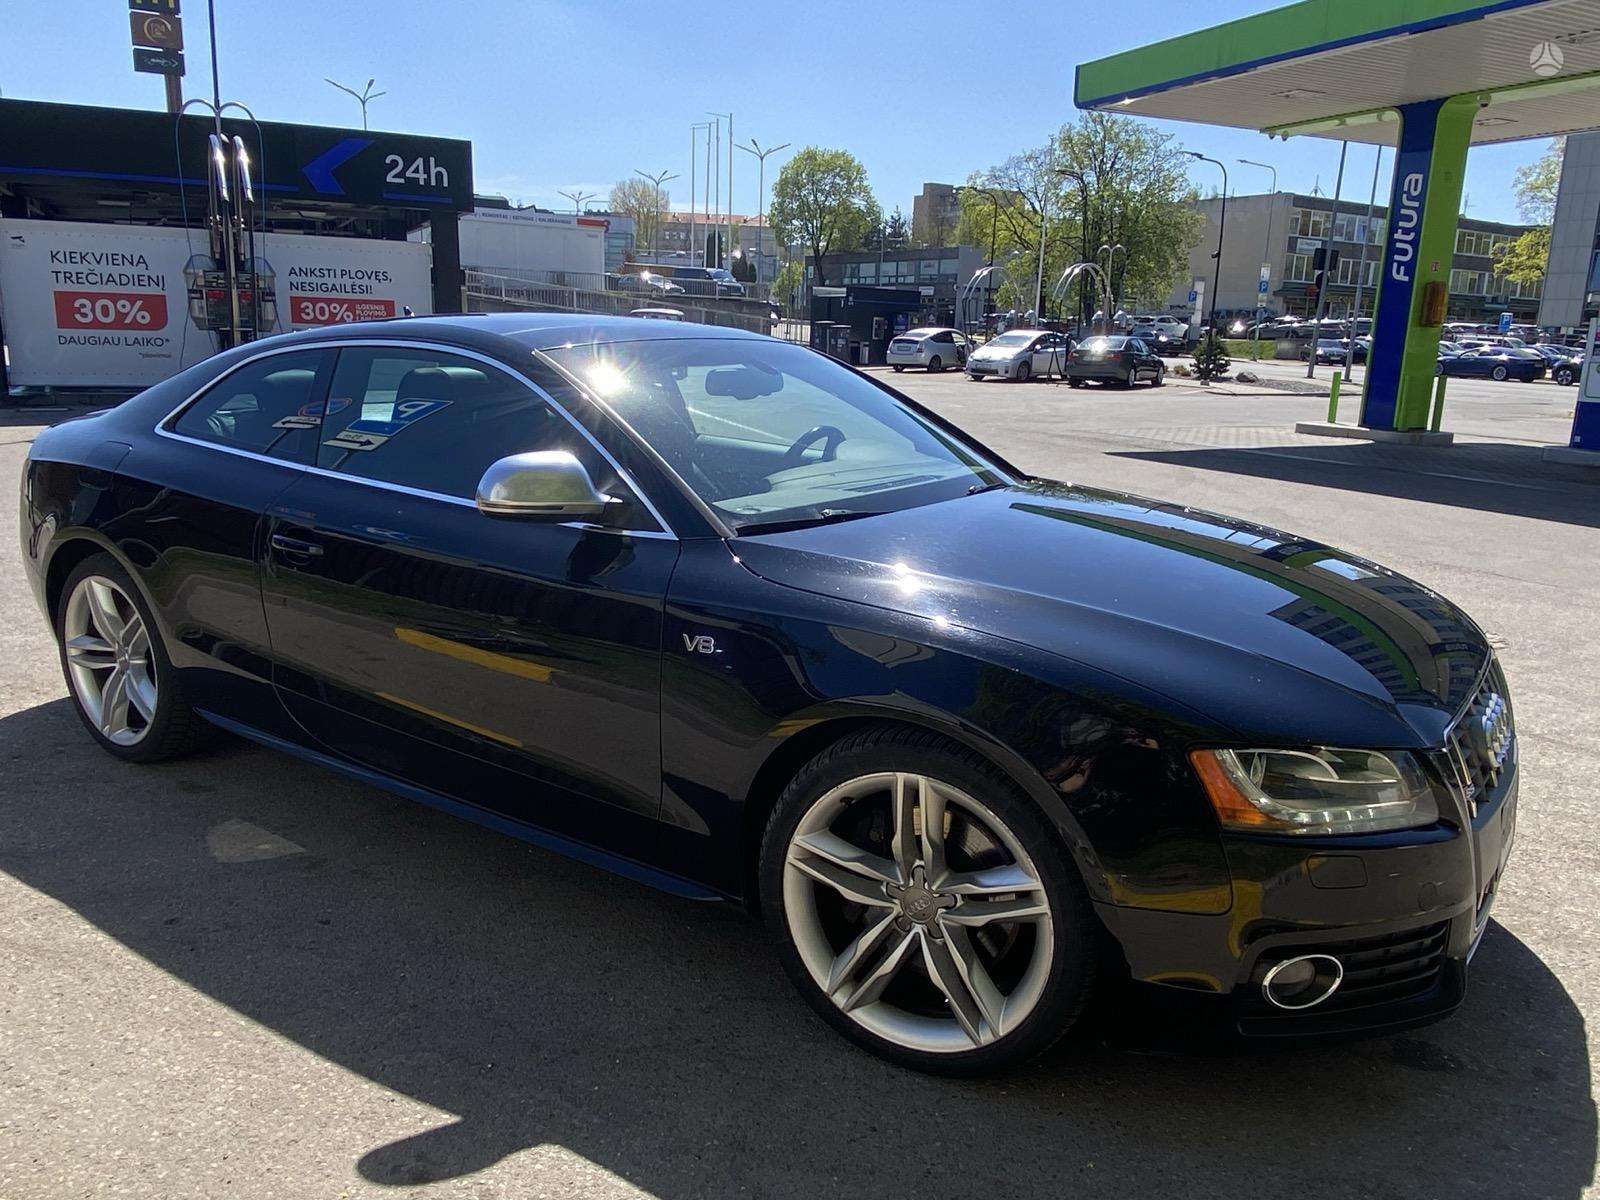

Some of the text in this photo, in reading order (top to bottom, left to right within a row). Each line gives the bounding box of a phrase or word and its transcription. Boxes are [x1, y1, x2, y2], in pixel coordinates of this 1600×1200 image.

[385, 154, 448, 187] 24h
[1391, 173, 1424, 282] Futura
[50, 250, 150, 270] KIEKVIENĄ
[51, 268, 166, 291] TREČIADIENĮ
[288, 266, 392, 284] ANKSTI PLOVĘS,
[289, 281, 373, 295] NESIGAILĖSI!
[73, 298, 151, 325] 30%
[300, 302, 353, 321] 30%
[58, 335, 121, 346] DAUGIAU
[682, 633, 715, 654] V8
